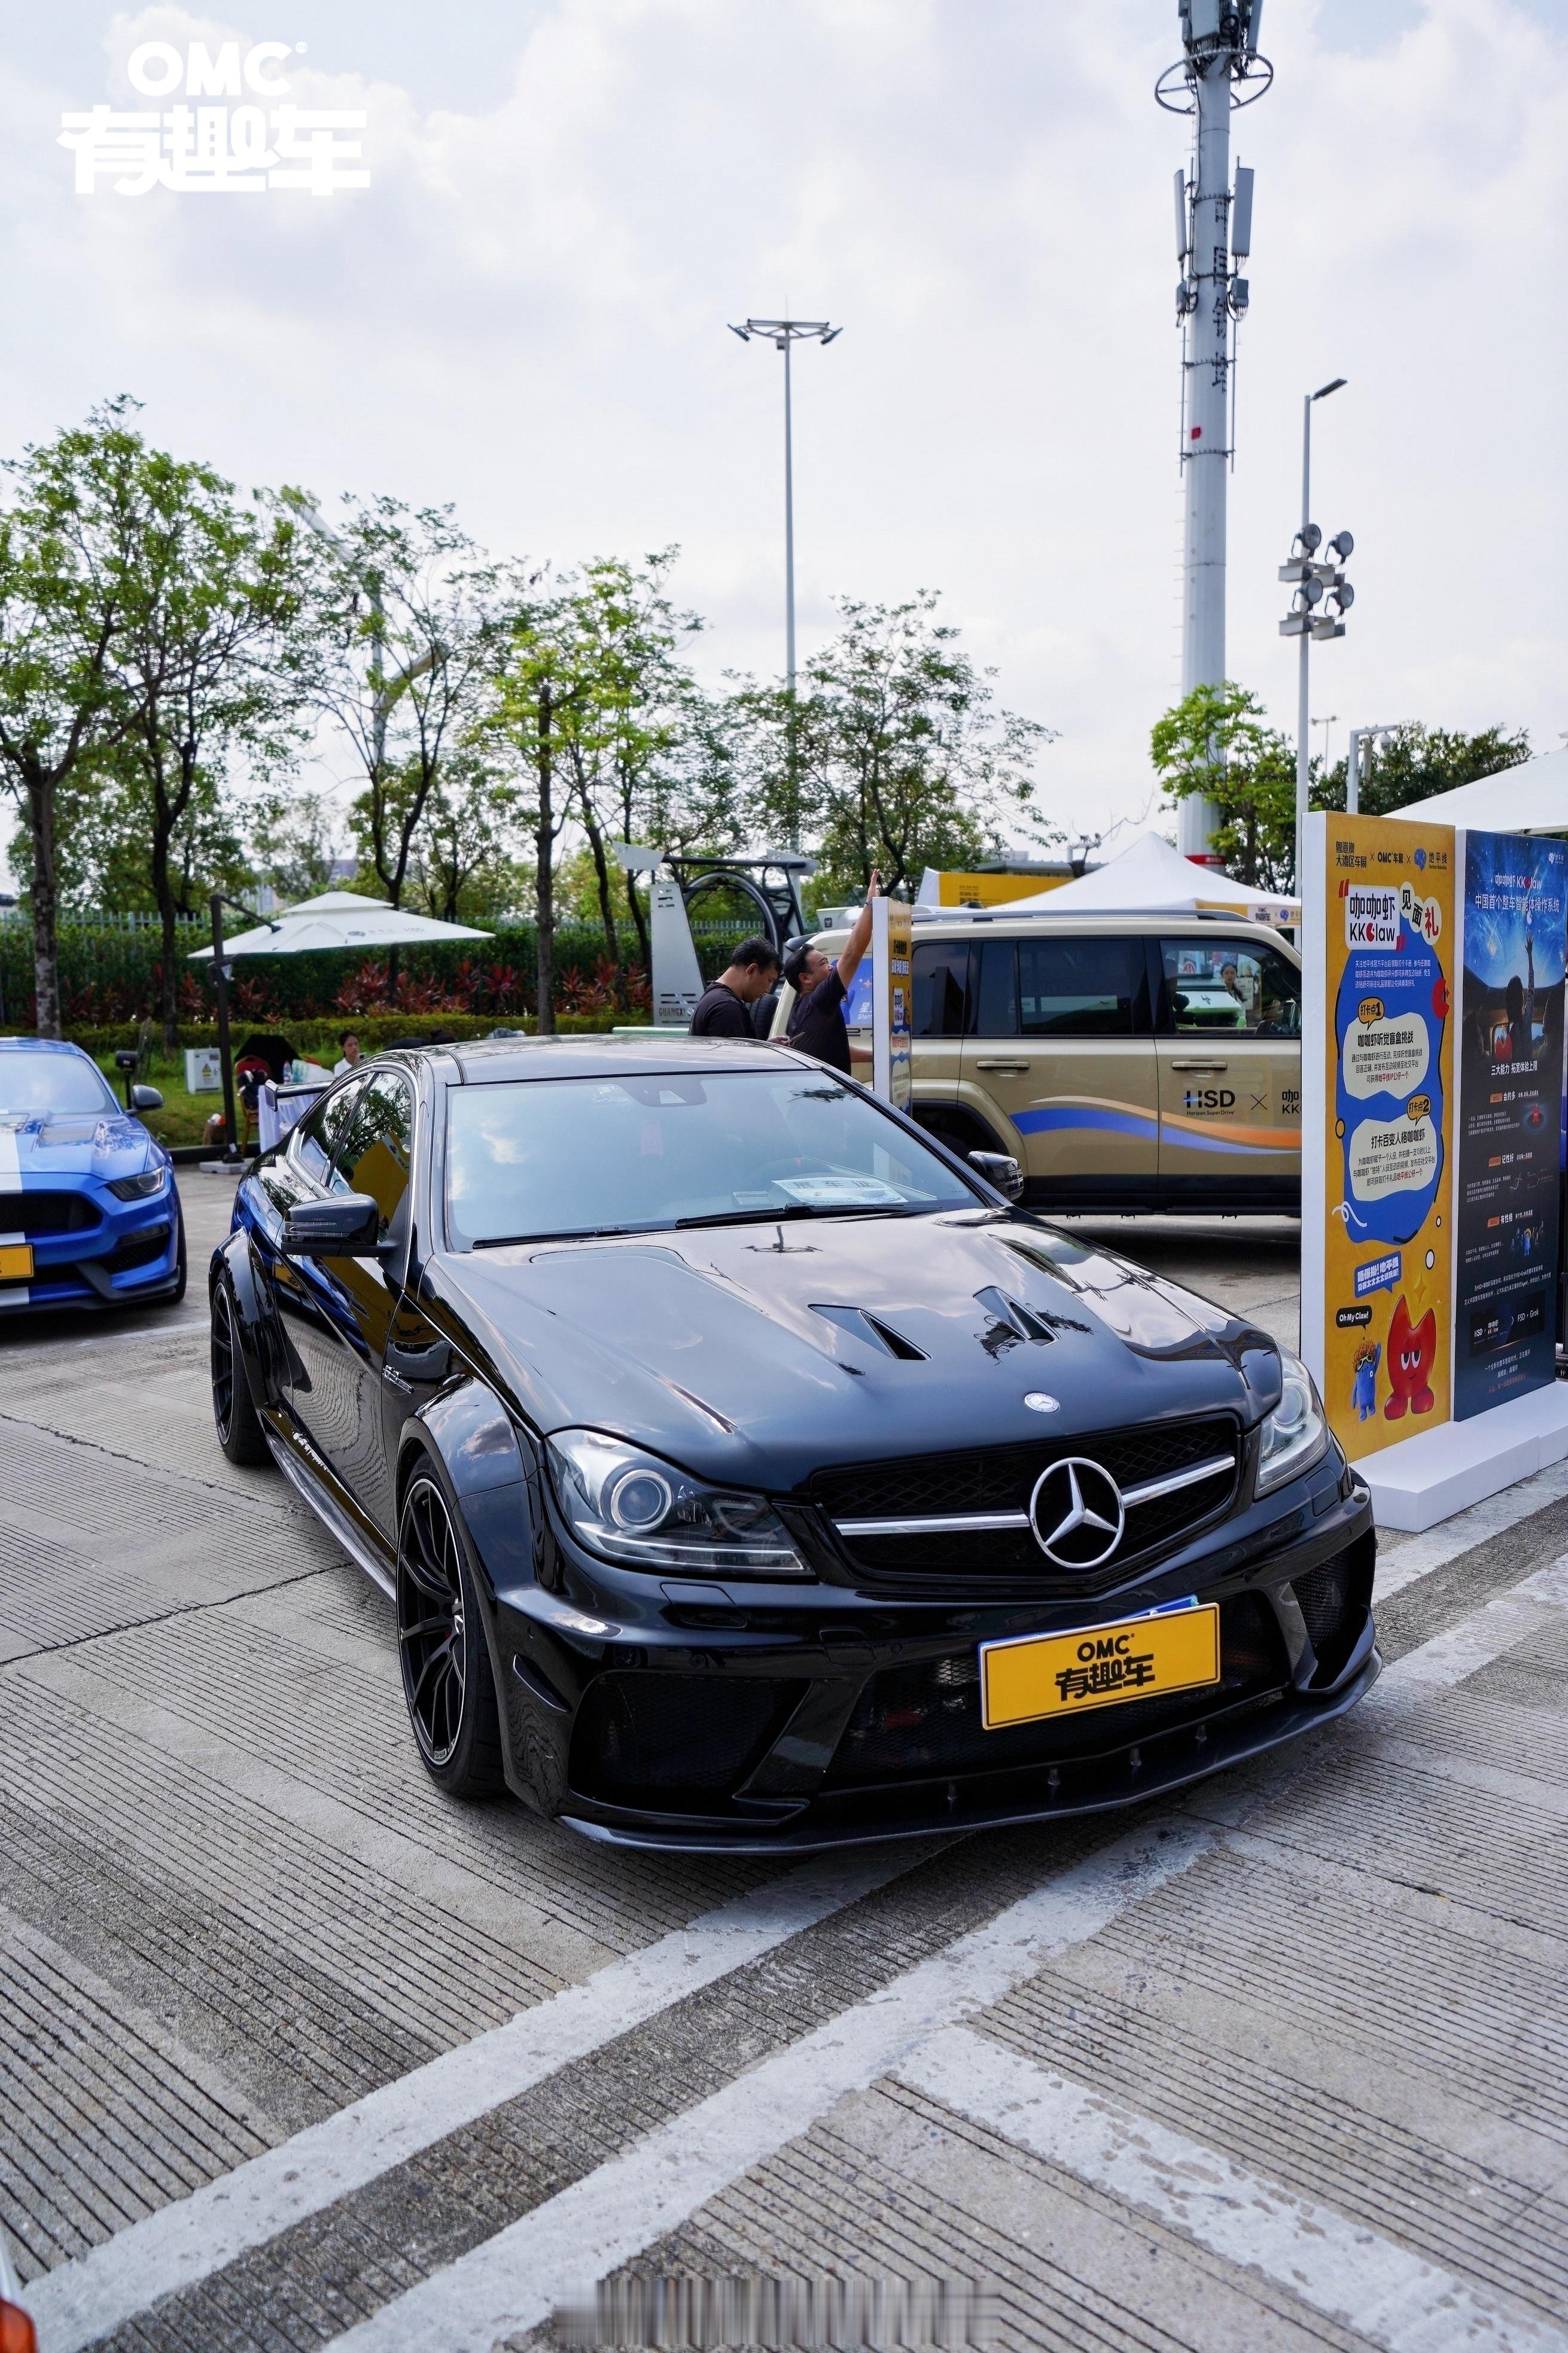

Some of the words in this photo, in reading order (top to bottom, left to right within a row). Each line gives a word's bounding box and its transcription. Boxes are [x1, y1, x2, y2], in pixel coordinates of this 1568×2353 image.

[1336, 841, 1354, 854] 粤港澳
[1336, 855, 1367, 867] 大湾区车展
[1378, 851, 1392, 863] OMC
[1429, 852, 1447, 864] 地平线
[1496, 873, 1515, 888] 咖咖虾
[1350, 892, 1395, 920] 咖咖虾
[1475, 894, 1559, 913] 中国首个整车智能体操作系统
[1402, 889, 1439, 939] 见面礼
[659, 1007, 685, 1017] GUANGXI
[1360, 1002, 1381, 1016] 打卡点1
[1357, 1030, 1414, 1048] 咖咖虾听觉盲盒挑战
[1491, 1065, 1509, 1076] 三大能力
[1511, 1060, 1537, 1074] 拓宽体验上限
[1183, 1089, 1235, 1108] HSD
[1503, 1091, 1515, 1101] 会的多
[1409, 1098, 1429, 1113] 打卡点2
[1371, 1128, 1425, 1149] 打卡百变人格咖咖虾
[1502, 1153, 1514, 1164] 记性好
[1500, 1213, 1513, 1225] 有性格
[1347, 1313, 1354, 1322] My
[1355, 1311, 1369, 1319] Claw!
[1517, 1313, 1526, 1323] FSD
[1530, 1308, 1539, 1319] Grok
[1474, 1328, 1482, 1338] HSD
[1077, 1634, 1130, 1663] OMC
[1055, 1653, 1156, 1702] 有趣车
